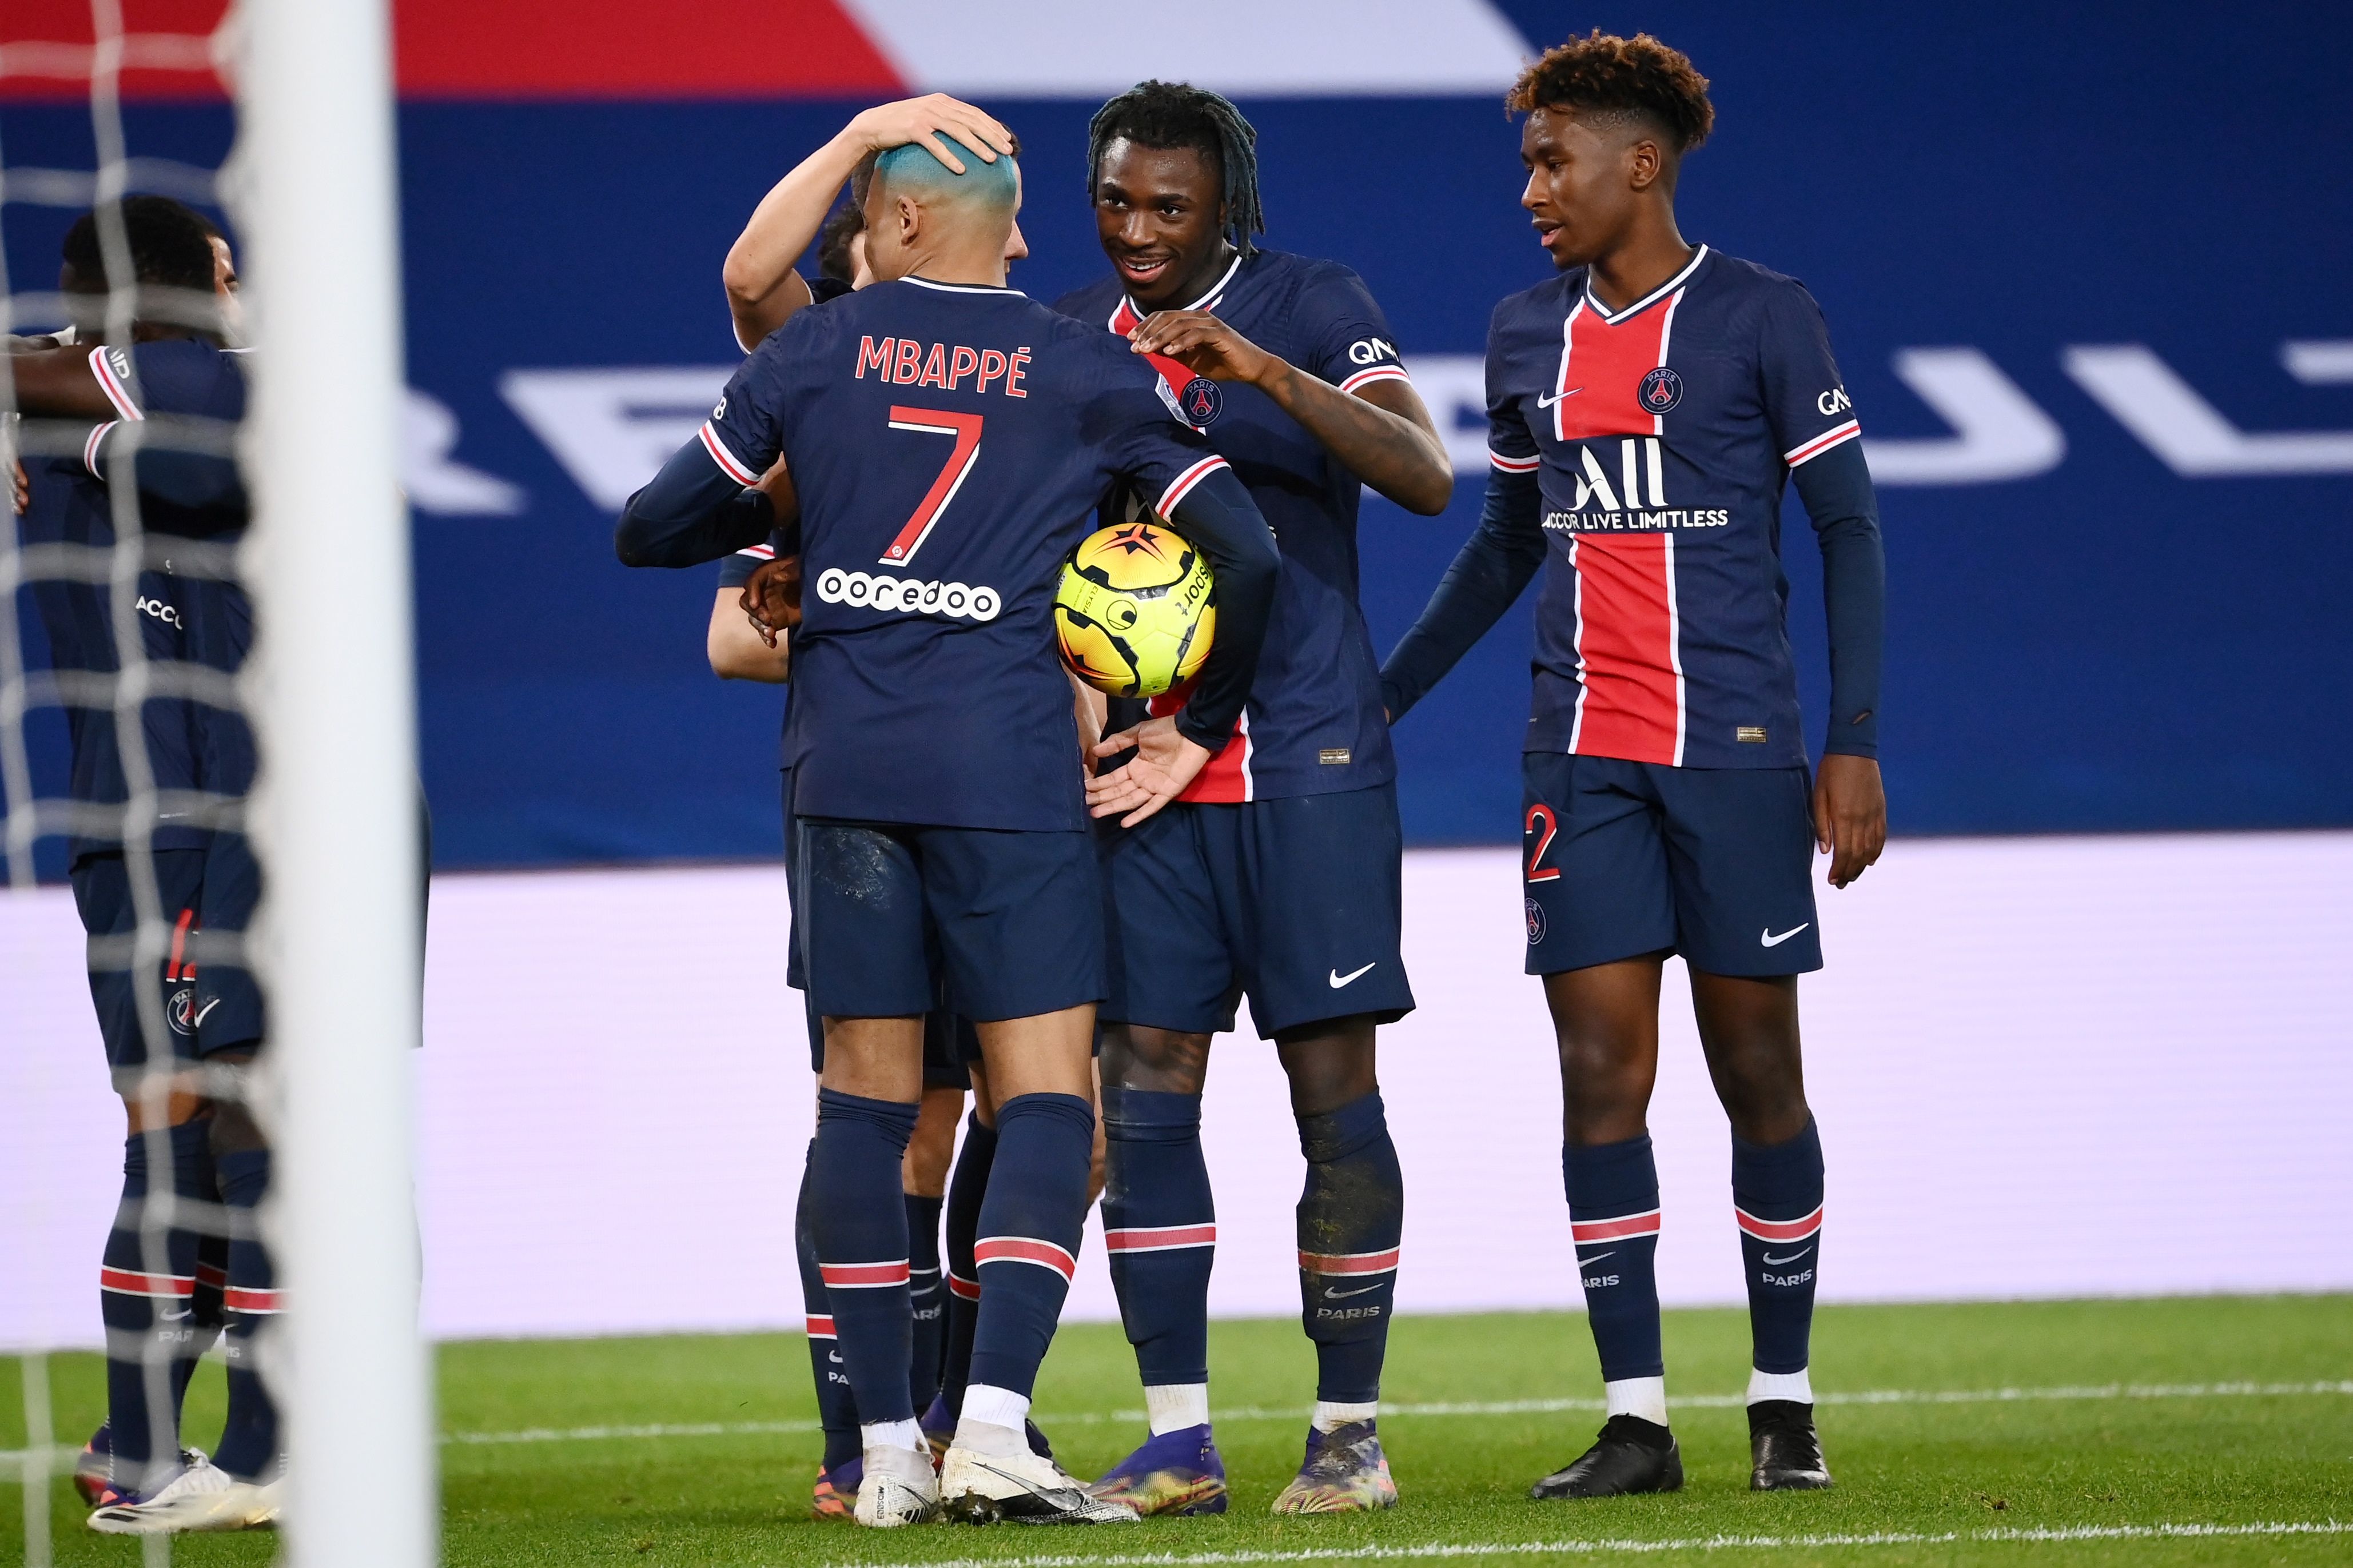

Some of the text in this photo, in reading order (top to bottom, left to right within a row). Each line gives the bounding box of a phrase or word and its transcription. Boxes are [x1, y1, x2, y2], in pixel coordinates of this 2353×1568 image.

[1349, 337, 1399, 364] QN
[855, 335, 1032, 398] MBAPPÉ
[1647, 370, 1676, 382] PARIS
[1188, 381, 1215, 393] PARIS
[1817, 384, 1852, 416] QN
[878, 405, 984, 567] 7
[1566, 437, 1669, 511] ALL
[1541, 509, 1729, 530] ACCOR LIVE LIMITLESS
[818, 569, 1000, 620] ooredoo
[1082, 585, 1098, 614] ELYSIA
[1762, 1269, 1812, 1287] PARIS
[1317, 1306, 1380, 1319] PARIS
